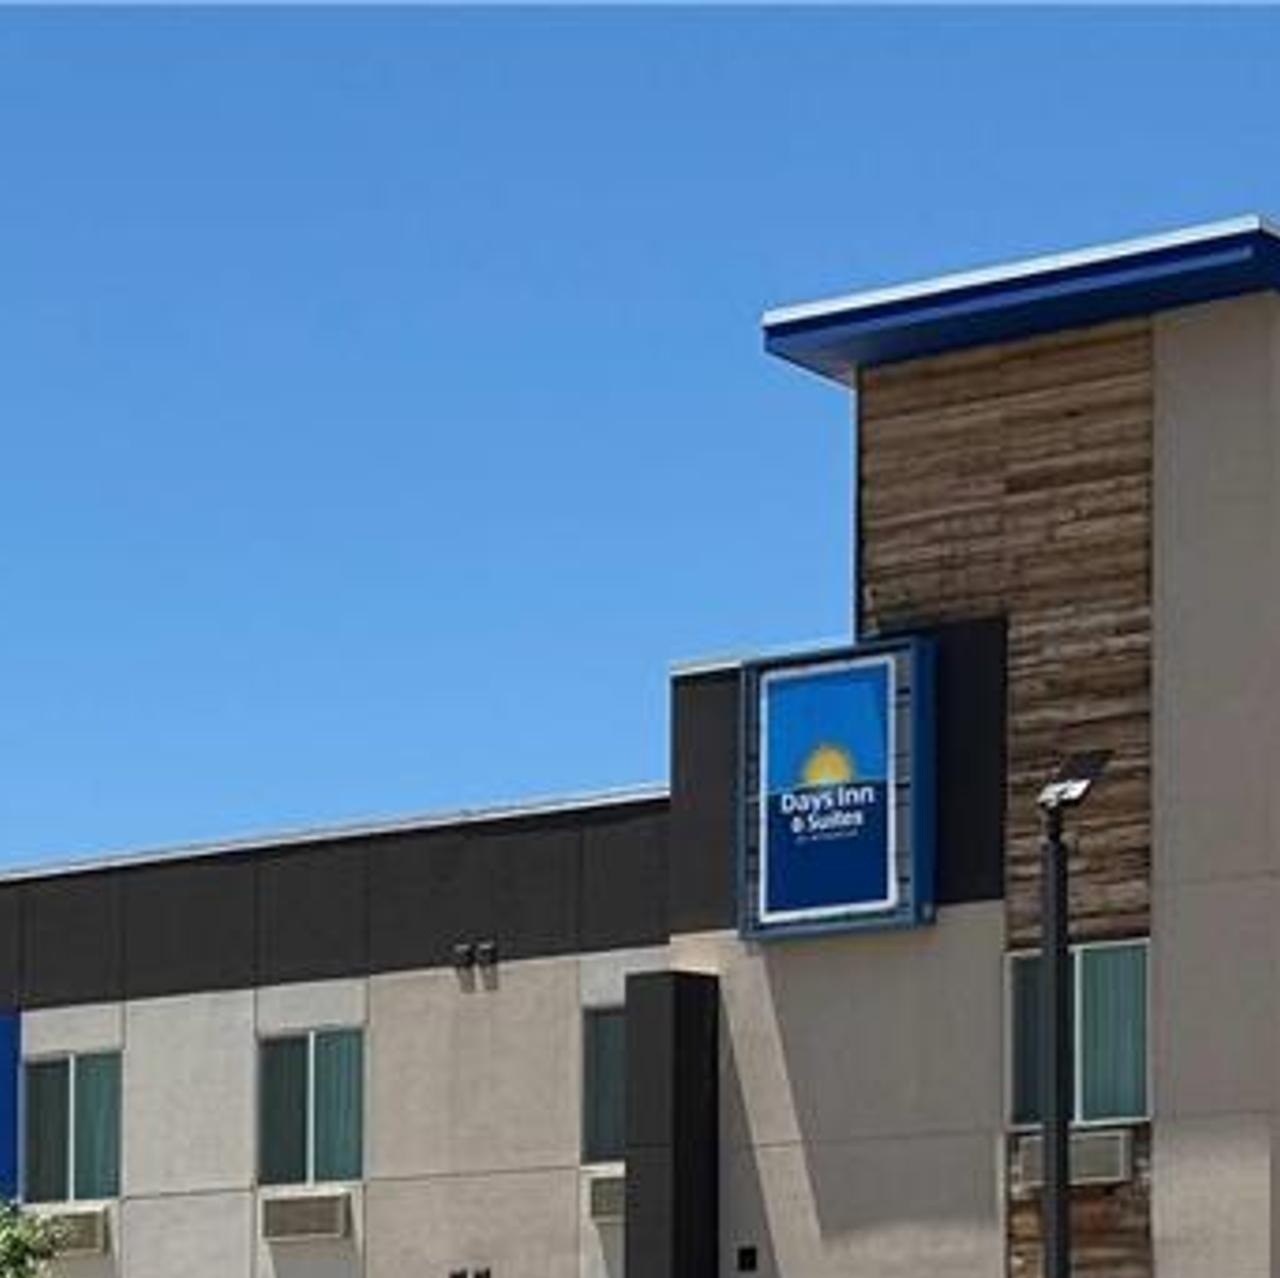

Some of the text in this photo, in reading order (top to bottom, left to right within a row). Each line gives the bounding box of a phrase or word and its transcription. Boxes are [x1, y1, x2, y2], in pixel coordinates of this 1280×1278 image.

[781, 786, 874, 814] Days Inn
[807, 810, 863, 831] Suites
